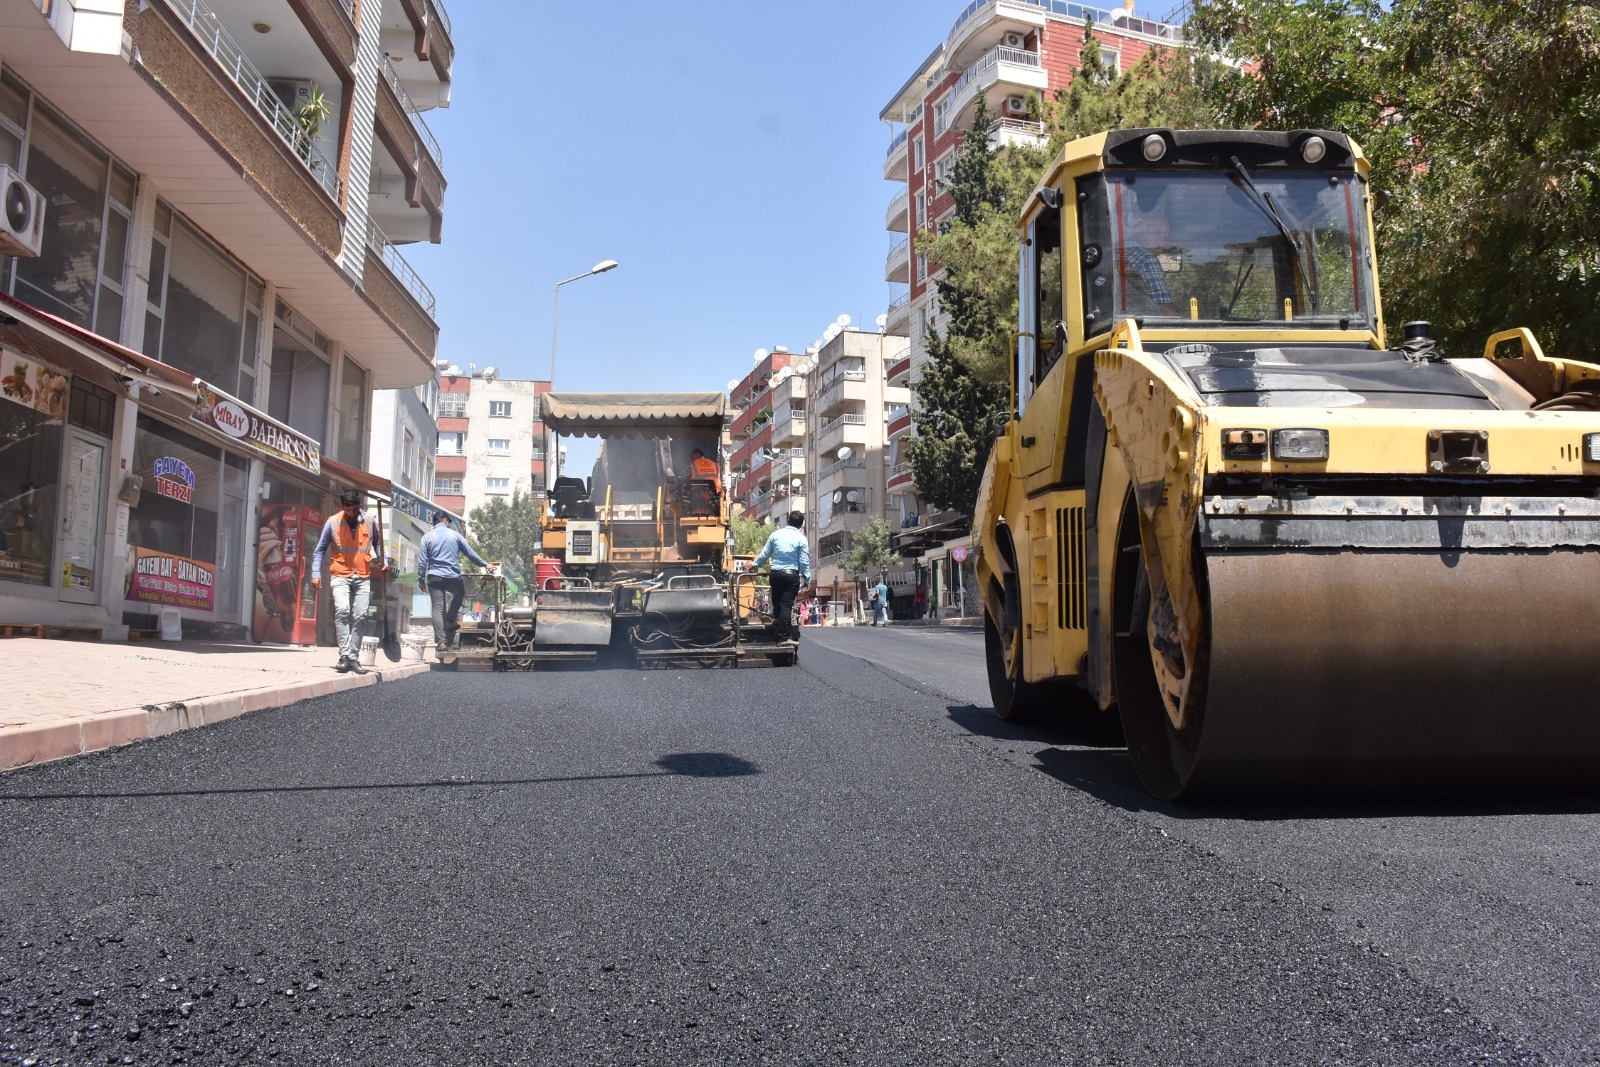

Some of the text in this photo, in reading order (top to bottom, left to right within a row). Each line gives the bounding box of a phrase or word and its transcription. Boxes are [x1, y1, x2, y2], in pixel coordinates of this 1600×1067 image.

[215, 406, 245, 431] MİRAY
[154, 456, 195, 491] GAYEM
[137, 556, 160, 576] GAYEM
[160, 557, 174, 578] BAY
[178, 559, 197, 583] BAYAN
